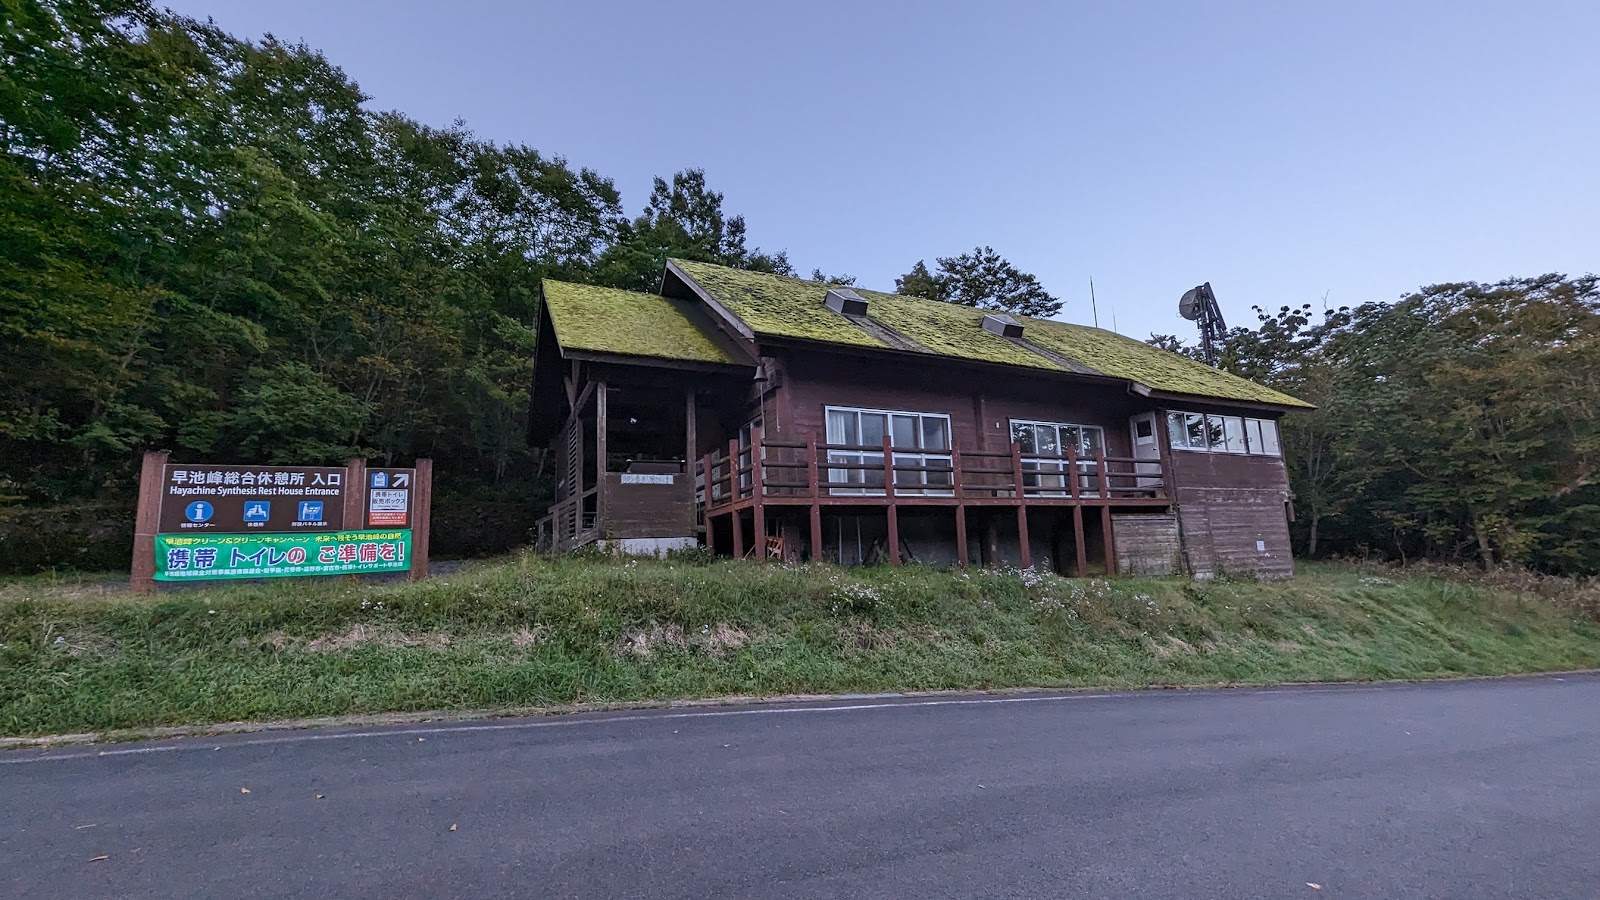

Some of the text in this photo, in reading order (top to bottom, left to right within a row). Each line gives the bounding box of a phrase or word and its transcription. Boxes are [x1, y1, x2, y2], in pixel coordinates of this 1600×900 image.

[171, 470, 341, 486] 早池峰総合休憩所 入口
[169, 485, 340, 497] Hayachine Synthesis Rest House Entrance
[167, 547, 217, 570] 携帯
[230, 546, 306, 567] トイレの
